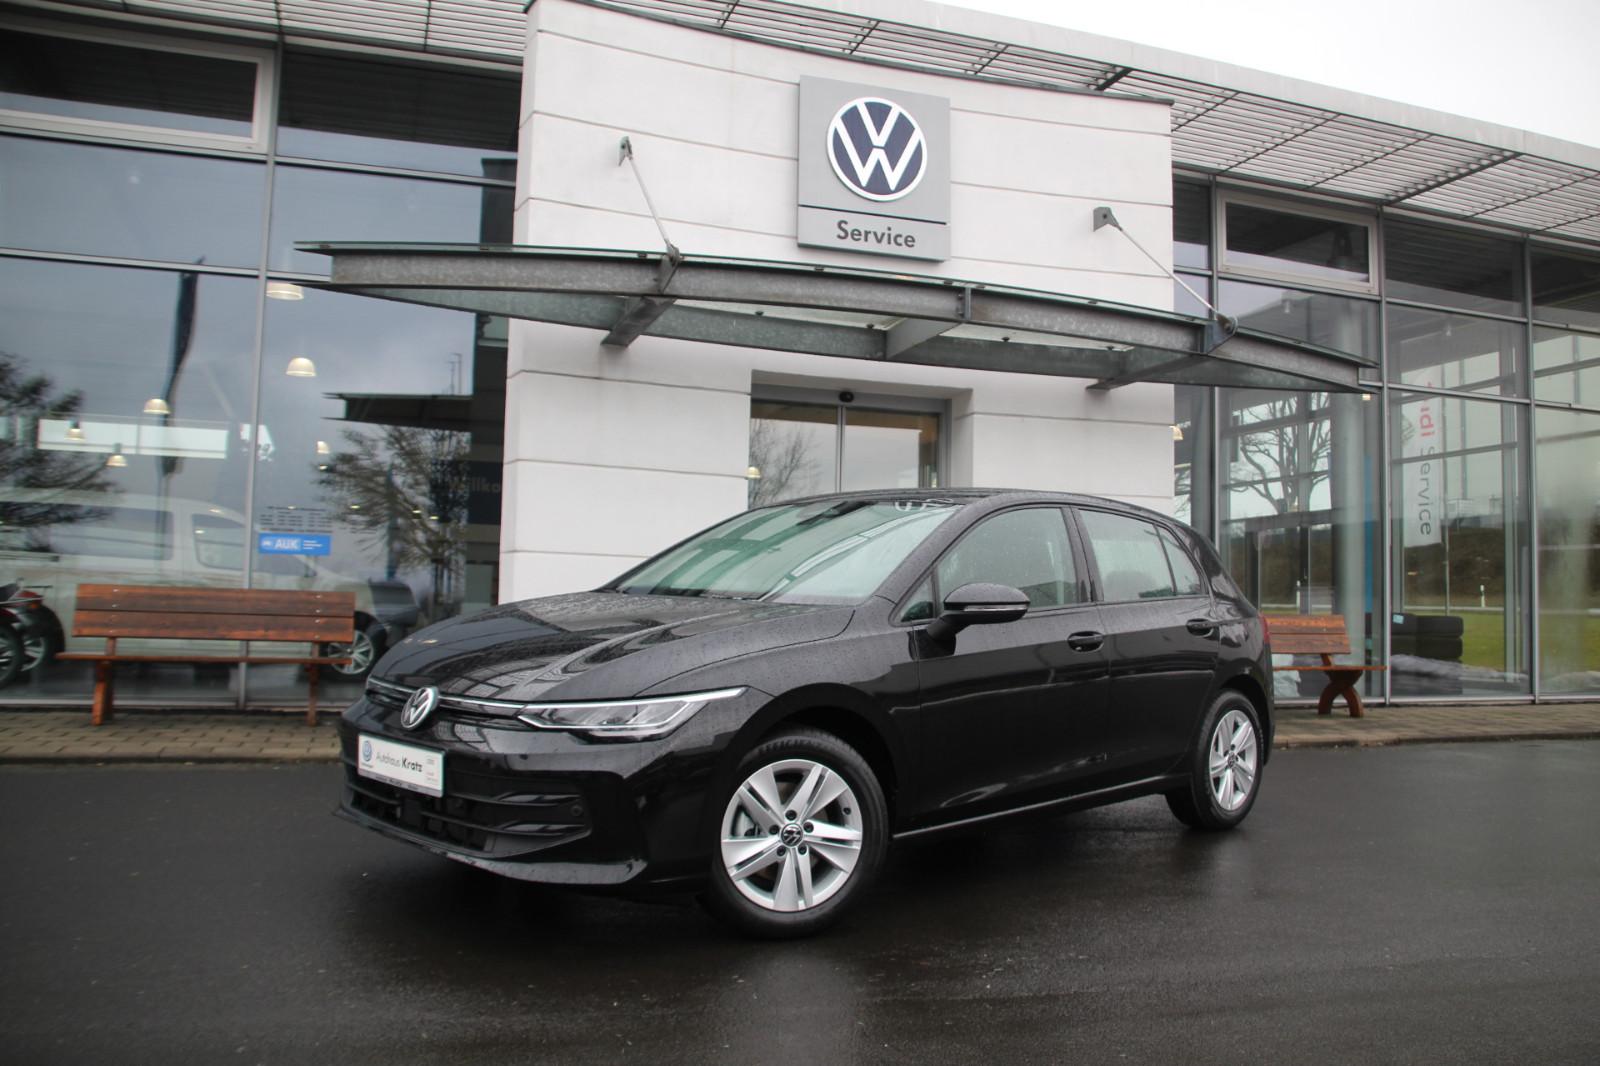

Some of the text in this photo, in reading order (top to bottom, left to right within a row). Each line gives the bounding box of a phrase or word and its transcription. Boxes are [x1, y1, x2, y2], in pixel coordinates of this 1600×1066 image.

[837, 220, 916, 247] Service
[1418, 446, 1435, 536] Service
[402, 757, 423, 773] Kratz
